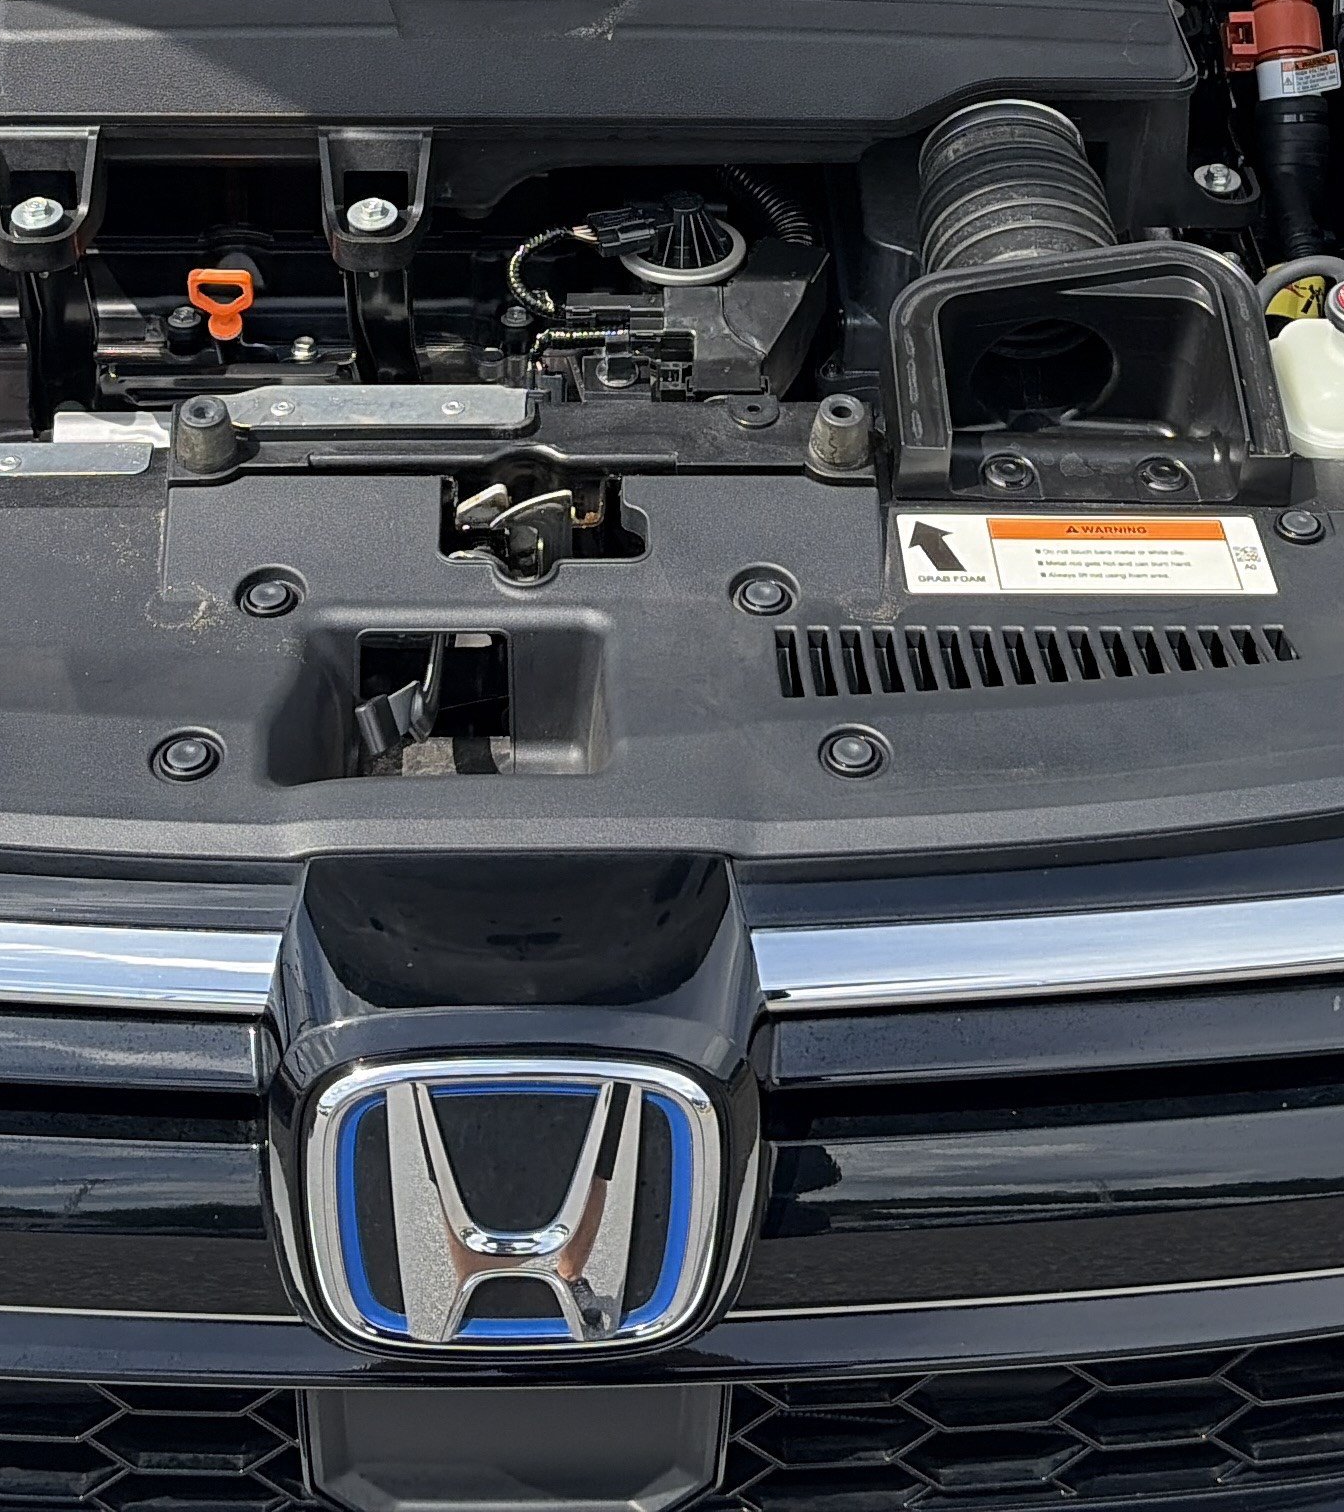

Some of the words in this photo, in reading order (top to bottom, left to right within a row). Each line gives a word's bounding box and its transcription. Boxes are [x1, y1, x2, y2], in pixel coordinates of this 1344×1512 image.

[1082, 526, 1147, 534] WARNING
[918, 575, 951, 583] GRAB
[953, 575, 987, 583] FOAM
